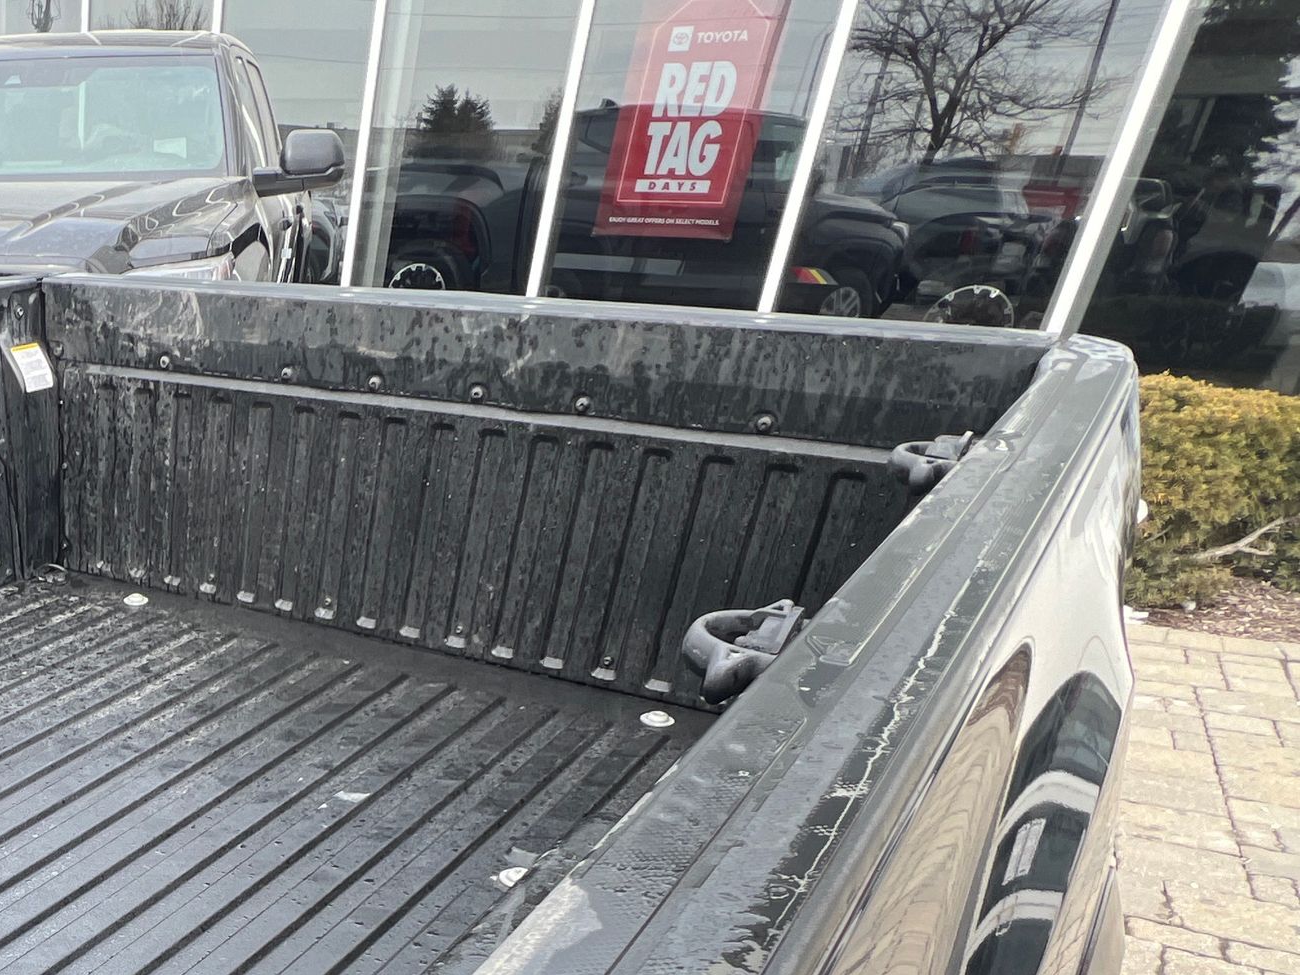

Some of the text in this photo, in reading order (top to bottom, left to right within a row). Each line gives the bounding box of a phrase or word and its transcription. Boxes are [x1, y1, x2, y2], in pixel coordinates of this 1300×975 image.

[697, 30, 748, 43] TOYOTA
[652, 60, 737, 118] RED
[644, 120, 723, 176] TAG
[648, 181, 697, 191] DAYS
